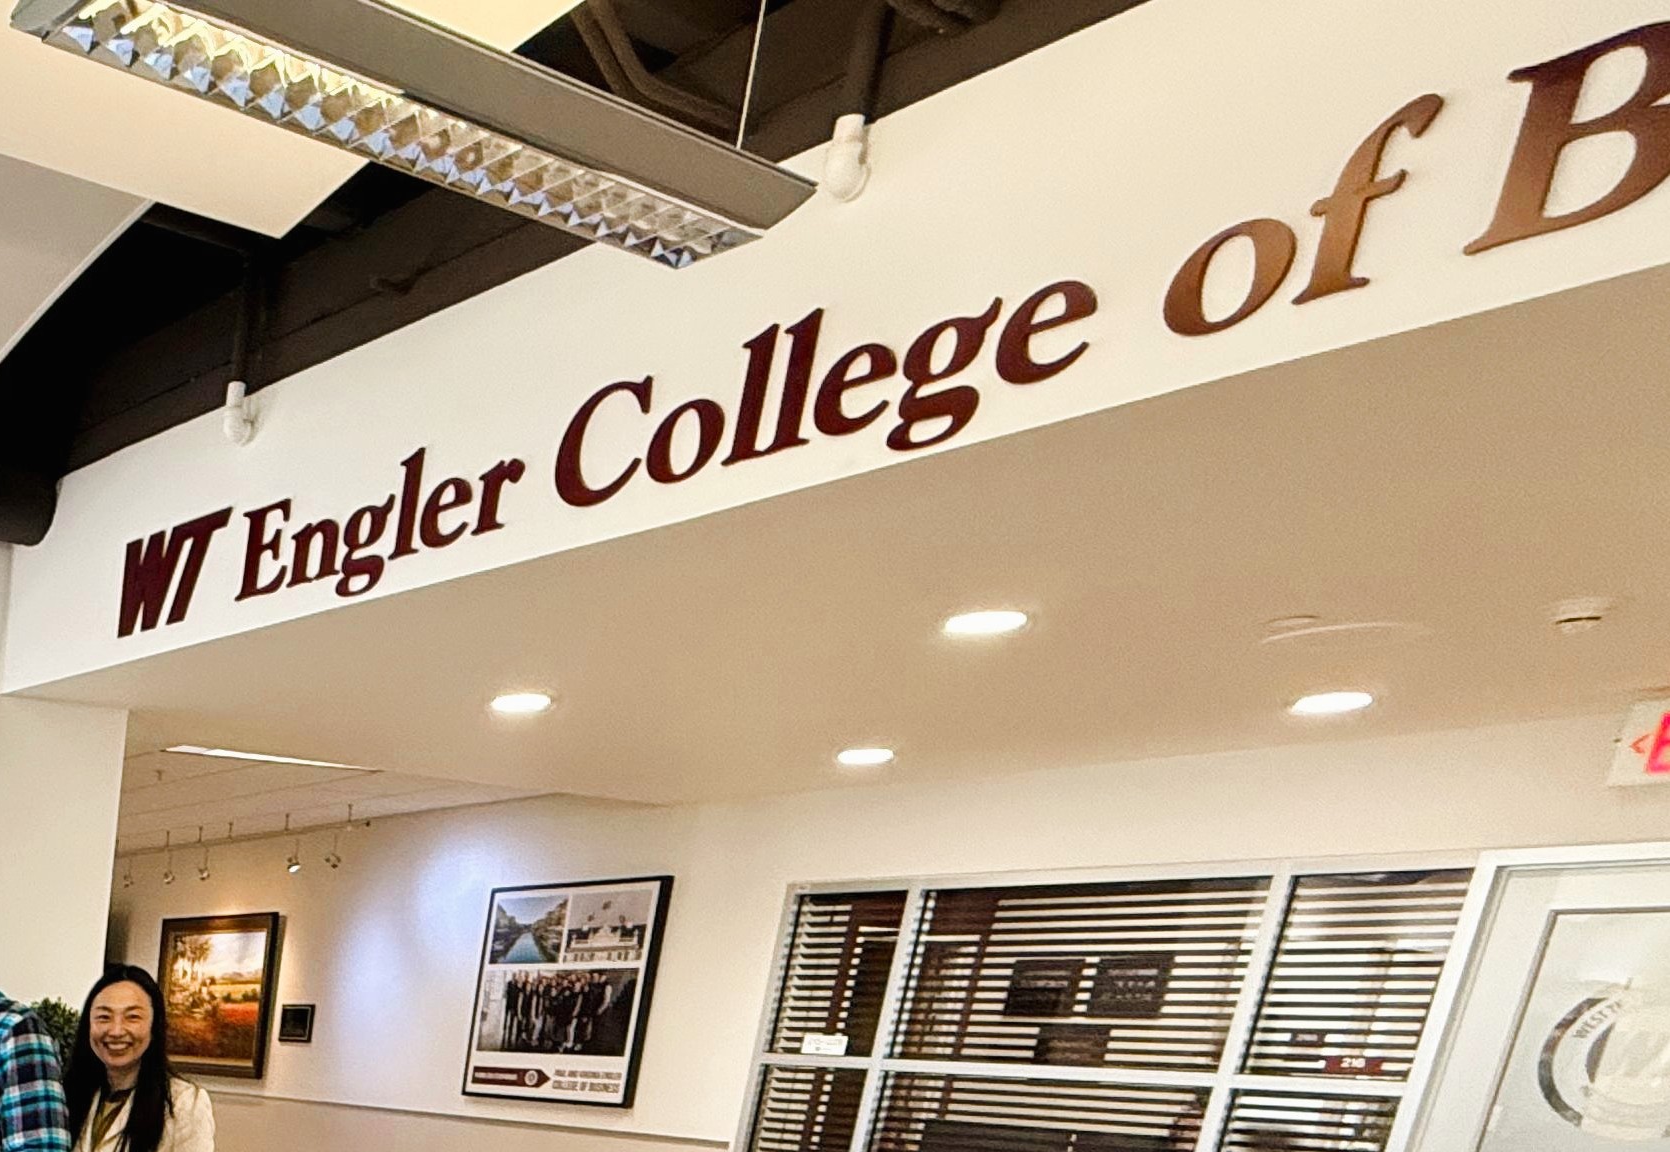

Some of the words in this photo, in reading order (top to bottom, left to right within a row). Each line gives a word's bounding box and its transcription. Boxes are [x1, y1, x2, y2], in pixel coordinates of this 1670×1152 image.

[118, 508, 233, 638] WT
[235, 447, 526, 602] Engler
[555, 279, 1099, 508] College
[1163, 93, 1445, 338] of
[1463, 20, 1670, 256] B
